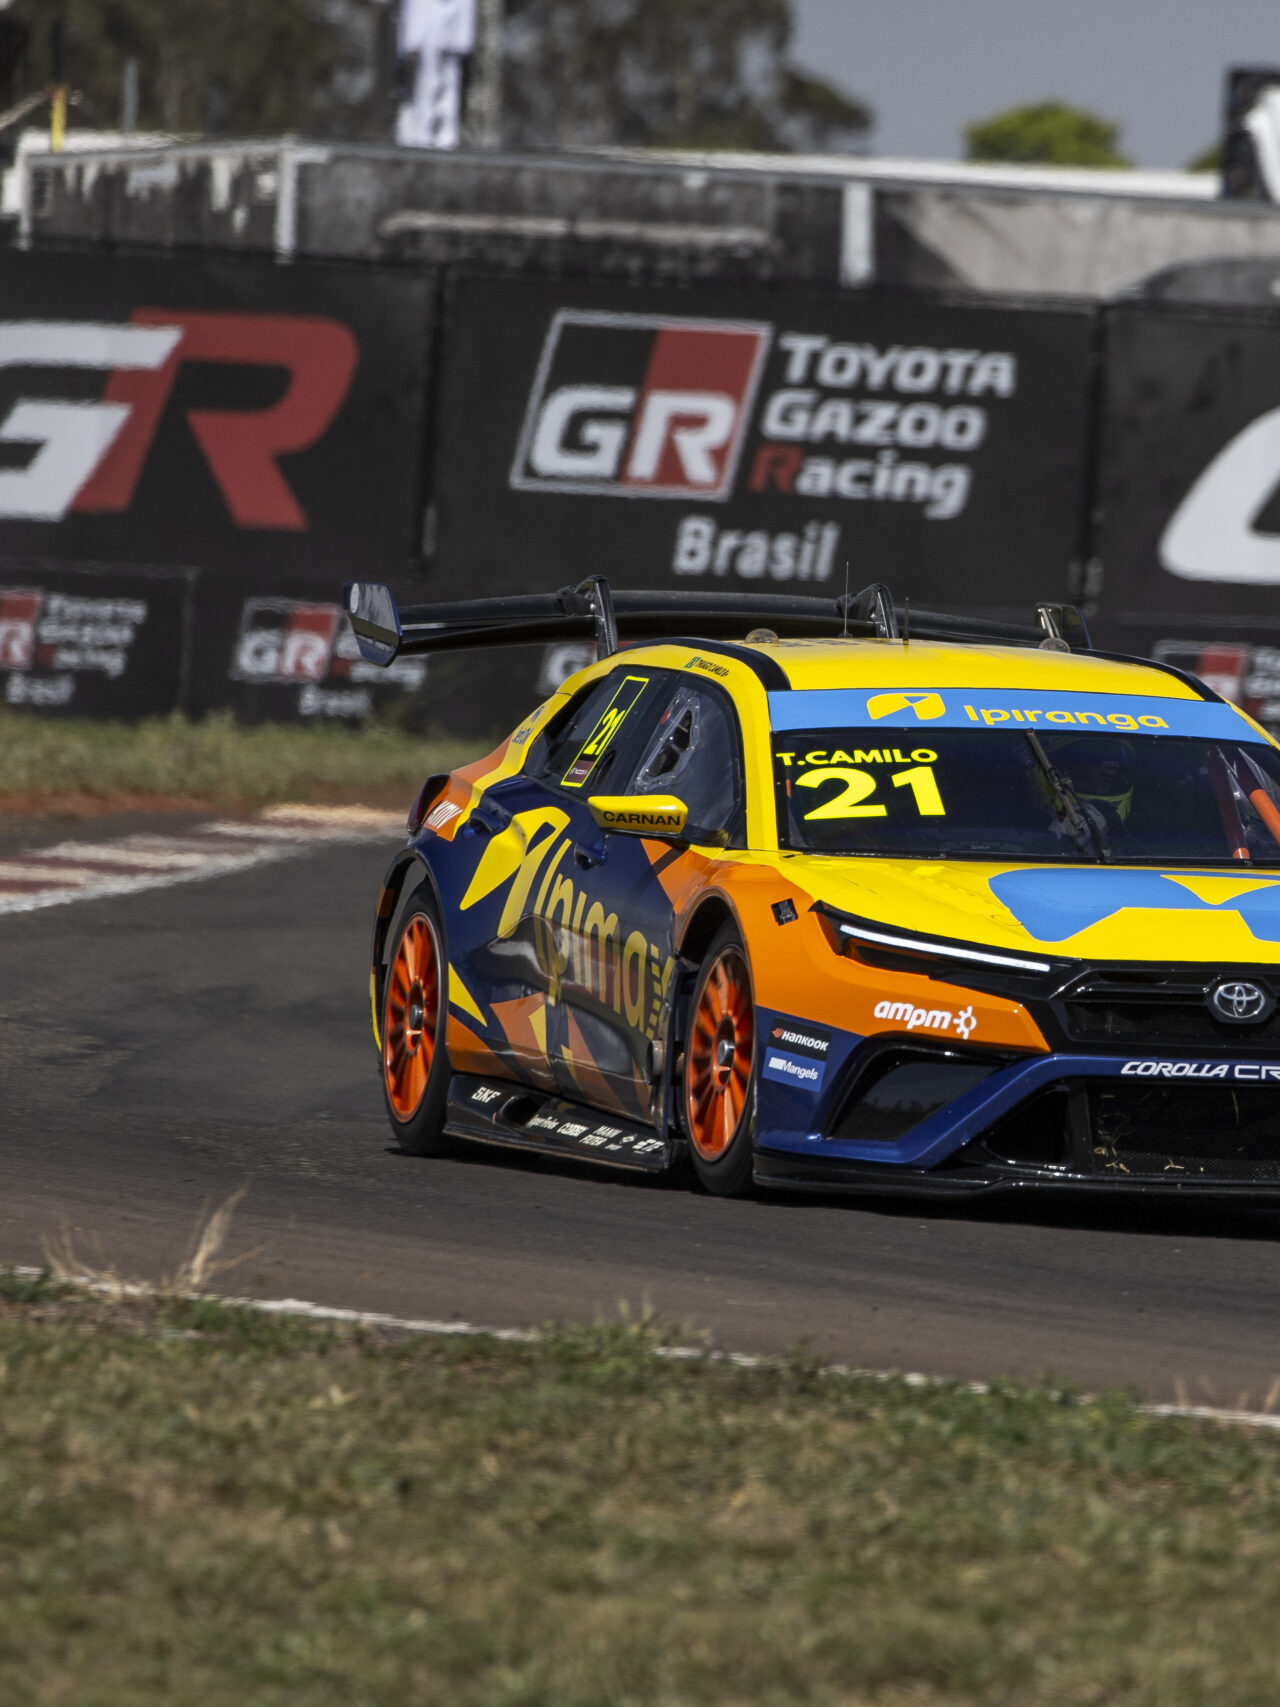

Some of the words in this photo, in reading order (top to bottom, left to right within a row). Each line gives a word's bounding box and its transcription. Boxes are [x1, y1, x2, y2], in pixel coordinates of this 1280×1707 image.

[776, 331, 1016, 397] TOYOTA
[529, 384, 735, 484] GR
[762, 389, 987, 450] GAZOO
[750, 442, 971, 519] Racing
[672, 515, 840, 581] Brasil
[236, 628, 330, 679] GR
[582, 707, 627, 755] 21
[963, 704, 1170, 732] Ipiranga
[776, 747, 938, 767] T.CAMILO
[795, 765, 946, 821] 21
[603, 810, 681, 826] CARNAN
[873, 1000, 953, 1030] ampm
[471, 1086, 501, 1103] SKF
[1120, 1061, 1231, 1079] COROLLA
